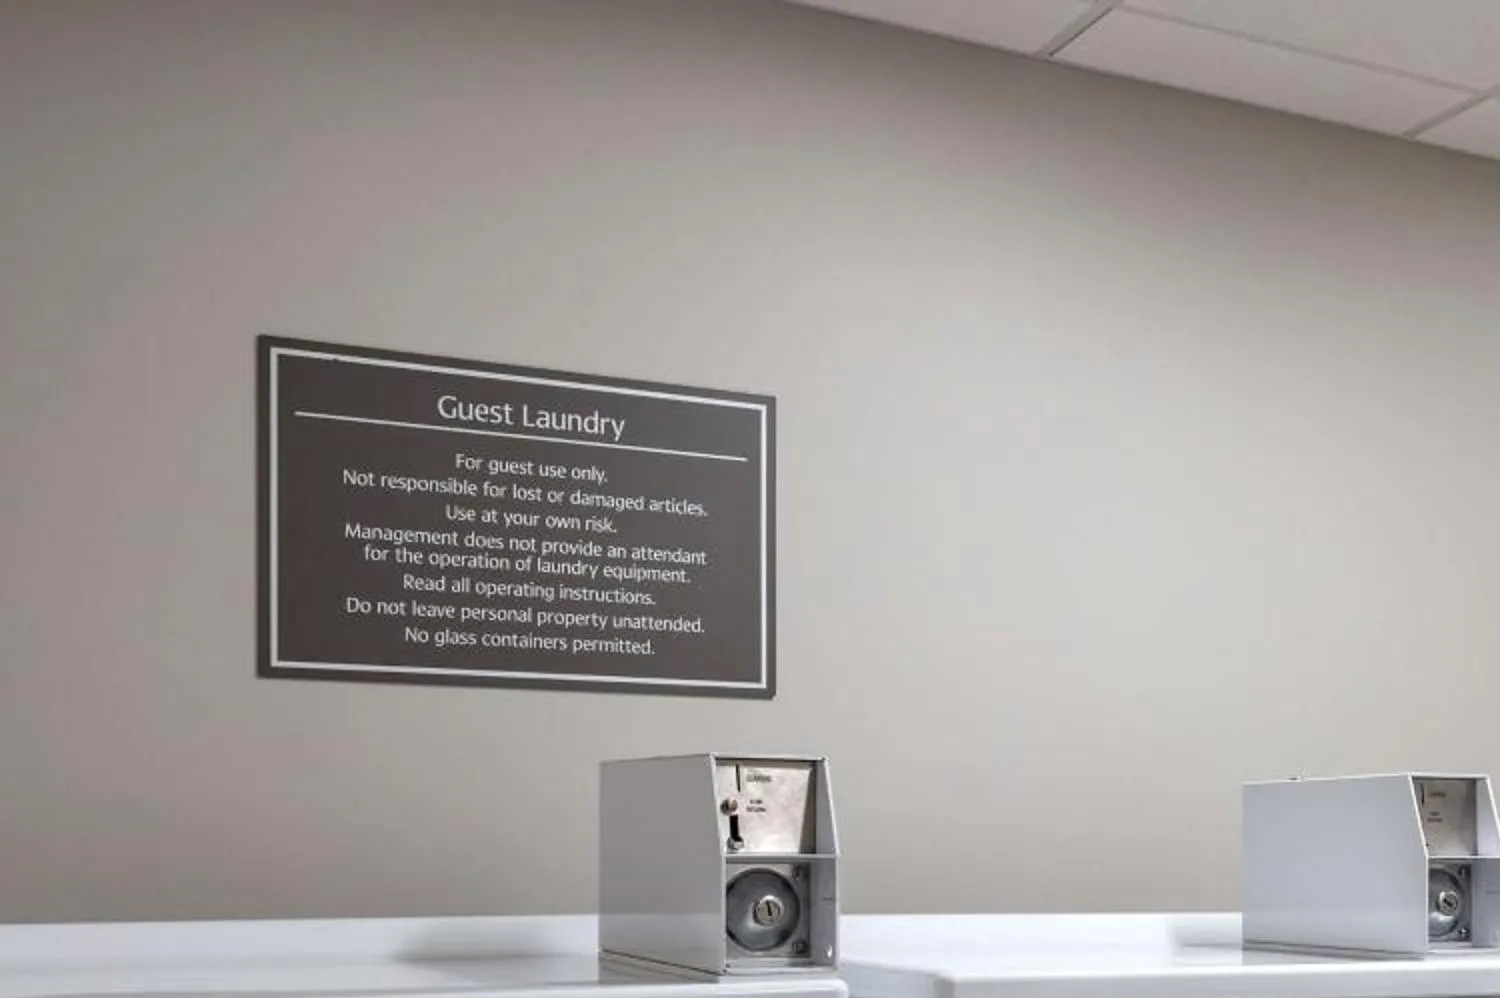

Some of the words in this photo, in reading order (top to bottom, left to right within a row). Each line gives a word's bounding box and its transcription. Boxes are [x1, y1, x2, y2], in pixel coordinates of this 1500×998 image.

[437, 395, 513, 425] Guest
[523, 404, 625, 441] Laundry
[455, 453, 483, 469] For
[488, 458, 534, 475] guest
[538, 463, 567, 478] use
[571, 465, 608, 484] only.
[343, 469, 375, 486] Not
[380, 474, 478, 495] responsible
[482, 481, 507, 497] for
[512, 484, 543, 501] lost
[547, 490, 565, 503] or
[569, 490, 645, 511] damaged
[649, 498, 707, 516] articles.
[446, 504, 476, 521] Use
[481, 509, 499, 523] at
[503, 512, 541, 528] your
[545, 516, 581, 528] own
[585, 516, 617, 533] risk.
[345, 523, 459, 546] Management
[464, 533, 504, 549] does
[509, 538, 537, 551] not
[541, 539, 603, 556] provide
[607, 545, 628, 558] an
[631, 545, 708, 565] attendant
[364, 545, 390, 560] for
[395, 548, 423, 564] the
[428, 552, 510, 570] operation
[515, 556, 533, 572] of
[537, 557, 599, 578] laundry
[603, 565, 691, 583] equipment.
[403, 574, 446, 591] Read
[451, 577, 471, 593] all
[475, 581, 555, 601] operating
[559, 584, 656, 605] instructions.
[347, 596, 373, 613] Do
[377, 600, 406, 614] not
[412, 600, 456, 618] leave
[461, 606, 533, 622] personal
[537, 610, 608, 628] property
[613, 614, 705, 633] unattended.
[405, 627, 429, 643] No
[434, 628, 477, 647] glass
[481, 632, 567, 650] containers
[573, 638, 655, 655] permitted.
